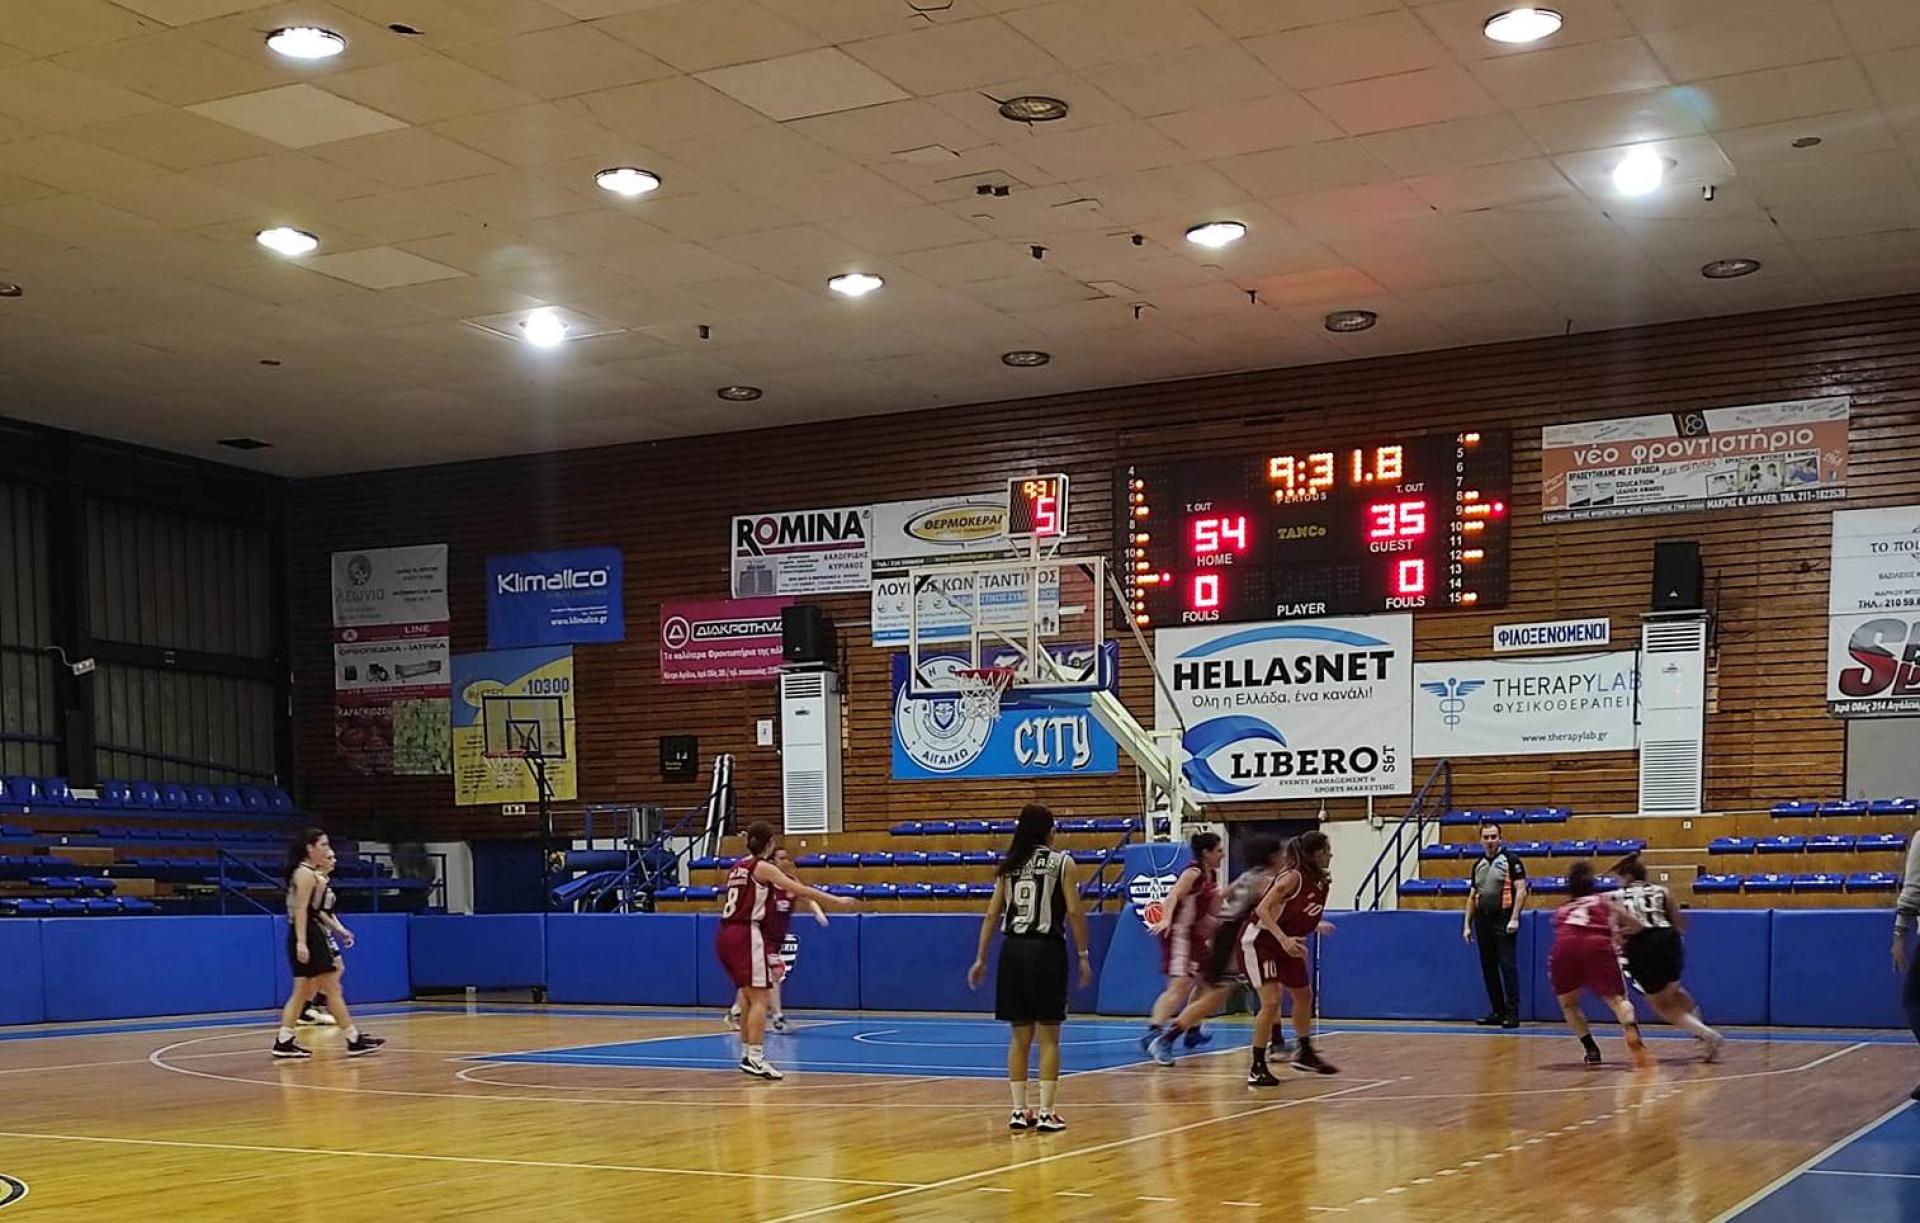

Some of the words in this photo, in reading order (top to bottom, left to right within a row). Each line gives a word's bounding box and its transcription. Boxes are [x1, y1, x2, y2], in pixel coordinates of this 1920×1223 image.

[1456, 433, 1464, 443] 4
[1573, 444, 1619, 466] νέο
[1631, 428, 1814, 464] φροντιστήριο
[1456, 448, 1463, 458] 5
[1128, 466, 1135, 476] 4
[1456, 462, 1463, 473] 6
[1128, 480, 1135, 489] 5
[1456, 476, 1463, 486] 7
[1128, 493, 1135, 502] 6
[1456, 491, 1463, 501] 8
[1036, 497, 1055, 534] 5
[1128, 506, 1135, 515] 7
[1456, 505, 1463, 516] 9
[1129, 520, 1136, 529] 8
[1370, 501, 1426, 537] 35
[1450, 521, 1463, 531] 10
[737, 511, 865, 556] ROMINA
[1129, 533, 1136, 543] 9
[1195, 516, 1247, 552] 54
[1370, 539, 1414, 553] GUEST
[1450, 536, 1462, 546] 11
[1125, 548, 1136, 558] 10
[1450, 550, 1462, 560] 12
[1125, 561, 1135, 571] 11
[1197, 554, 1233, 567] HOME
[1449, 564, 1462, 574] 13
[497, 566, 608, 594] Klimallco
[1125, 575, 1136, 585] 12
[1398, 559, 1426, 593] 0
[1449, 578, 1462, 588] 14
[1125, 588, 1136, 598] 13
[1195, 574, 1219, 607] 0
[1386, 596, 1426, 610] FOULS
[1449, 592, 1462, 603] 15
[1885, 599, 1901, 608] 210
[1277, 603, 1326, 616] PLAYER
[1182, 610, 1219, 623] FOULS
[404, 624, 432, 634] LINE
[1173, 650, 1395, 691] HELLASNET
[1223, 696, 1232, 708] η
[1294, 689, 1319, 702] ένα
[1323, 686, 1374, 701] κανάλι!
[1014, 714, 1094, 769] CITY
[1522, 730, 1608, 743] www.therapylab.gr
[1231, 746, 1378, 779] LIBERO
[722, 887, 739, 918] 8
[1013, 880, 1037, 934] 9
[1302, 902, 1323, 917] 10
